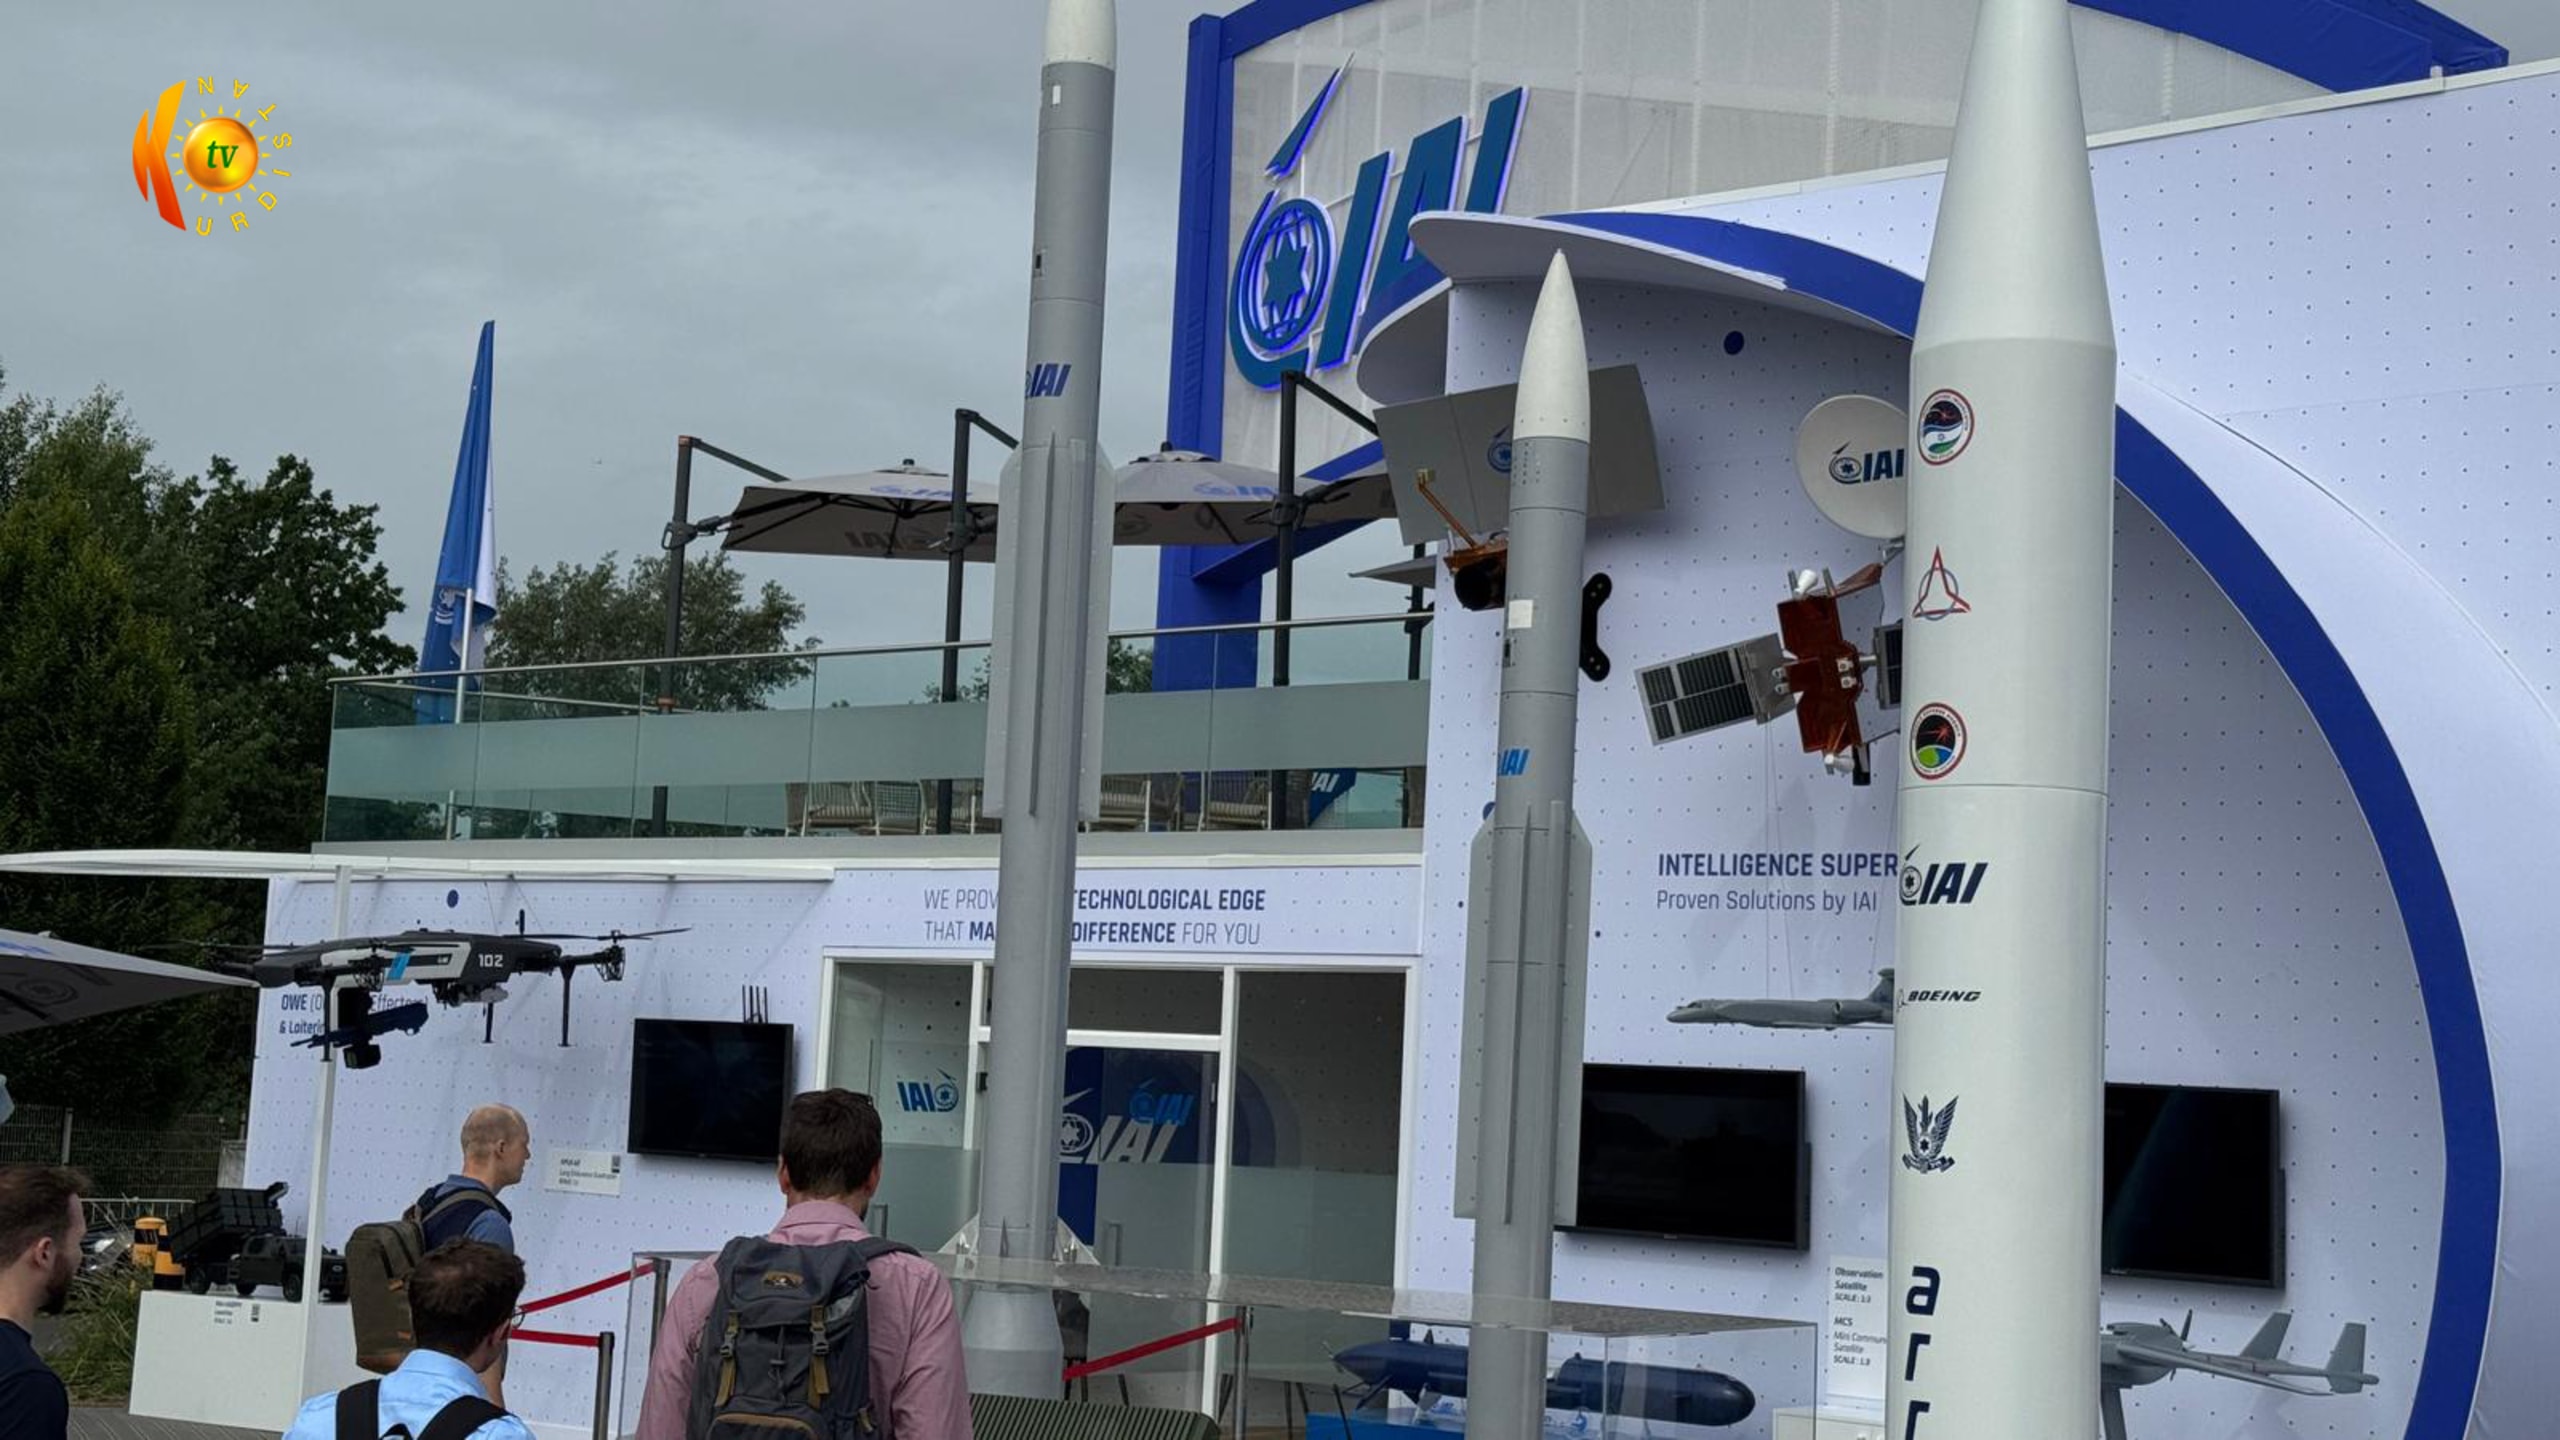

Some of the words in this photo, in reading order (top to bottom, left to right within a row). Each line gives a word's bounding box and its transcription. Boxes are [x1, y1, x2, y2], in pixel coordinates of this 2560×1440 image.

[1030, 363, 1072, 397] IAI
[1863, 448, 1905, 482] IAI
[1501, 749, 1530, 776] IAI
[1658, 853, 1814, 877] INTELLIGENCE
[1820, 853, 1899, 877] SUPER
[1919, 863, 1988, 904] IAI
[924, 888, 950, 910] WE
[955, 888, 999, 910] PROV
[1074, 889, 1213, 911] ECHNOLOGICAL
[1218, 889, 1267, 912] EDGE
[1656, 889, 1720, 910] Proven
[1726, 889, 1816, 911] Solutions
[1822, 890, 1846, 916] by
[1852, 892, 1878, 911] IAI
[924, 920, 966, 942] THAT
[969, 921, 996, 942] MA
[1071, 922, 1177, 944] DIFFERENCE
[1182, 923, 1218, 945] FOR
[1224, 923, 1261, 946] YOU
[478, 953, 504, 968] 102
[281, 993, 308, 1011] OWE
[1907, 990, 1982, 1002] BOEING
[1085, 1115, 1179, 1164] IAI
